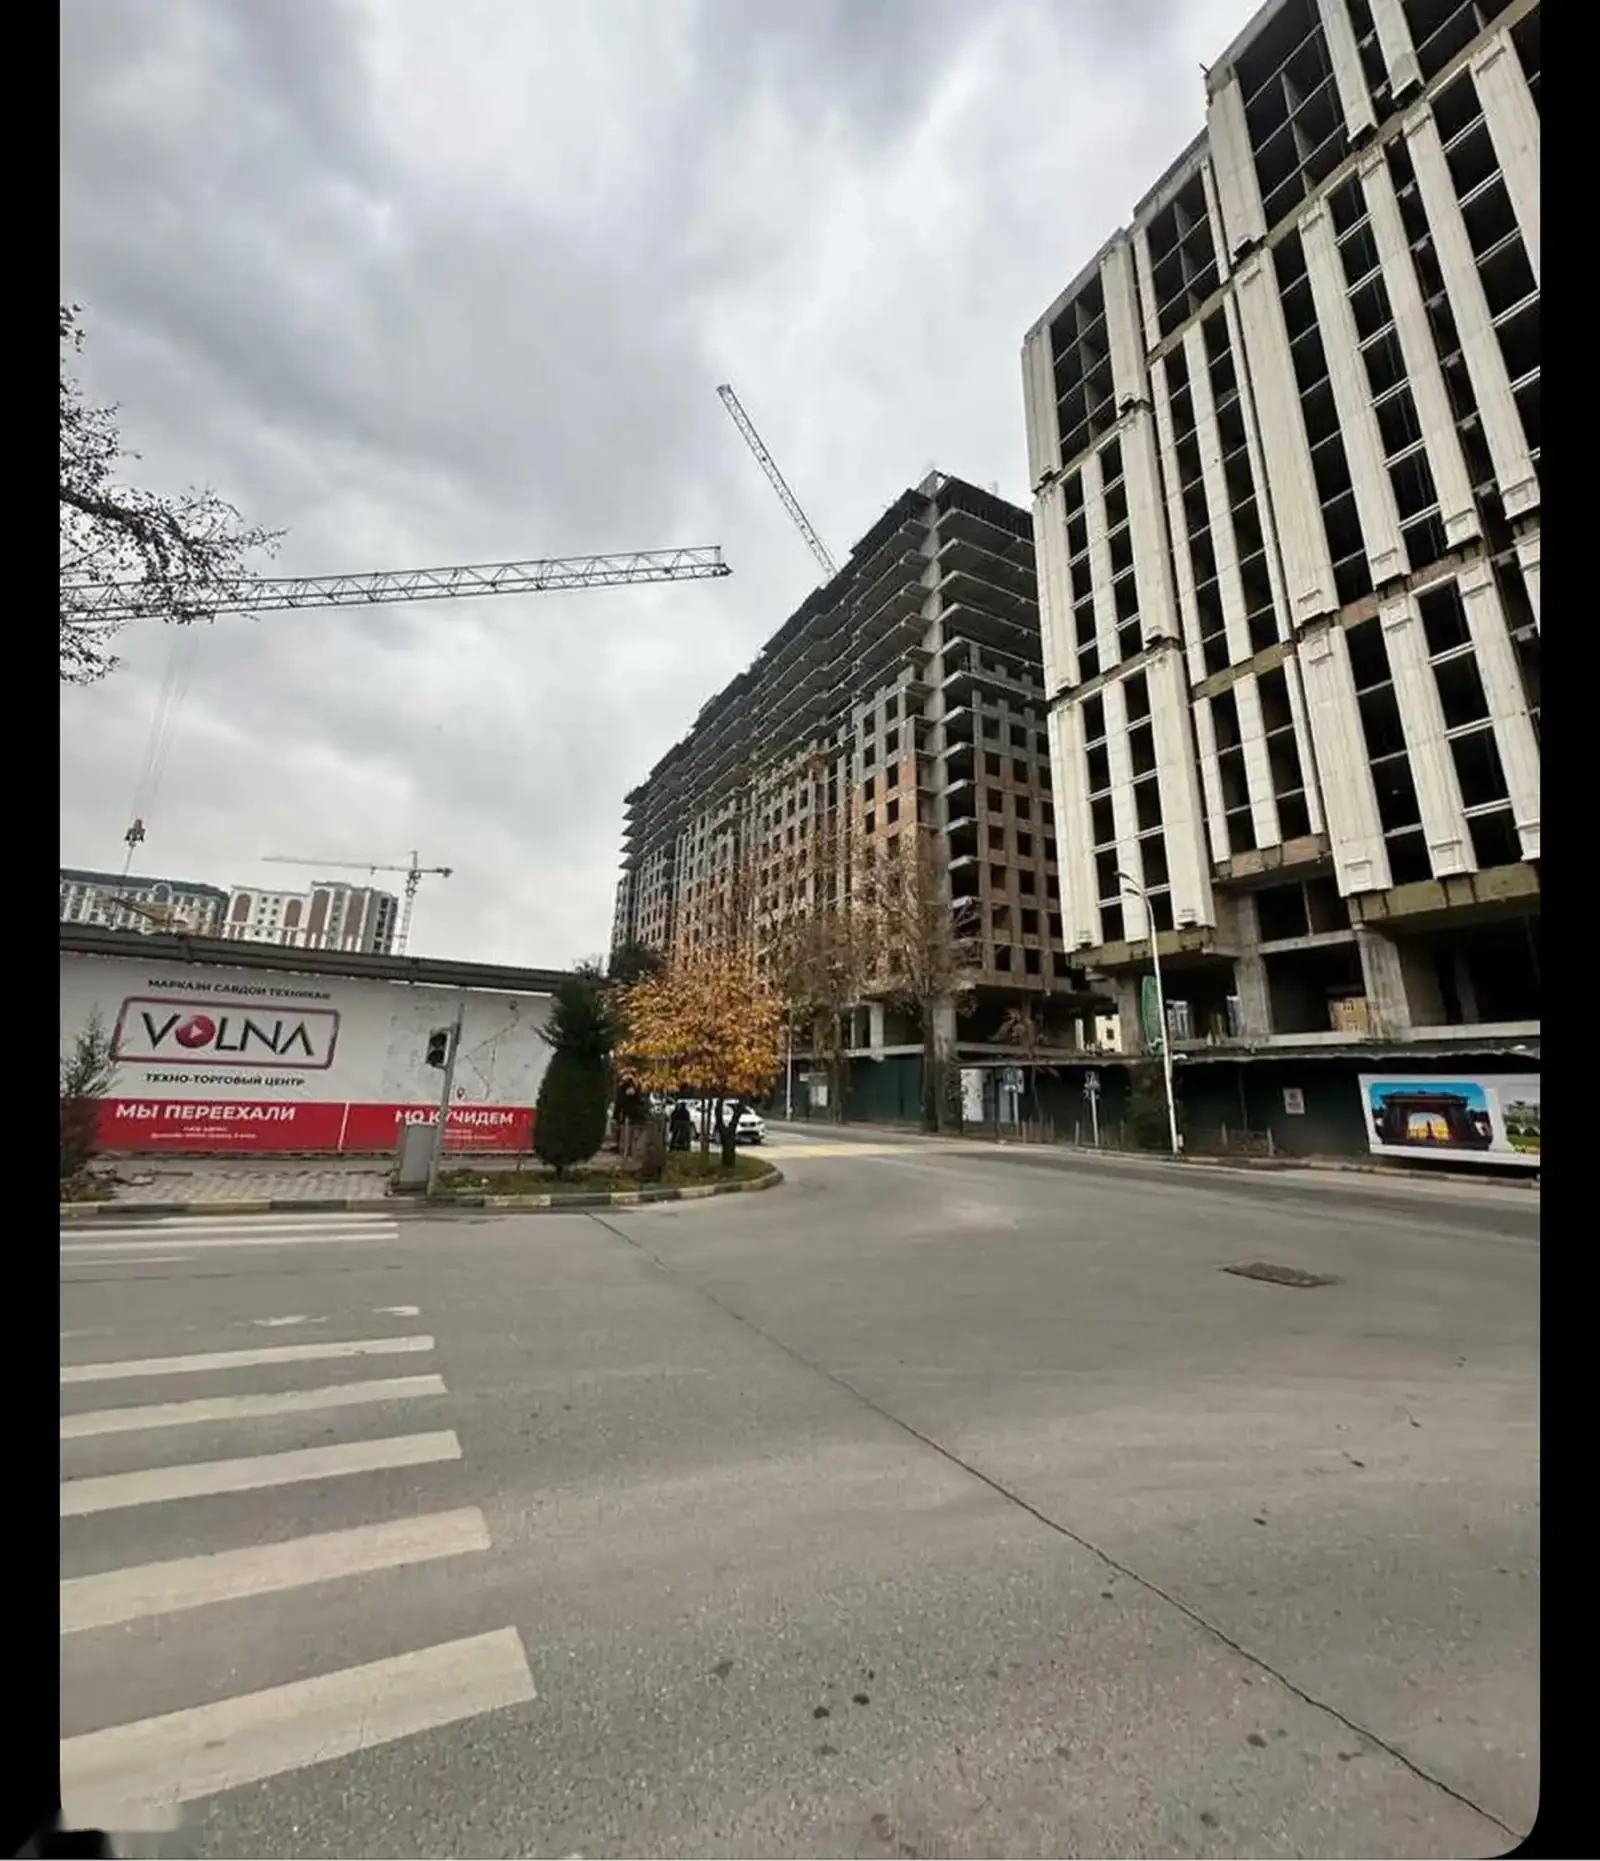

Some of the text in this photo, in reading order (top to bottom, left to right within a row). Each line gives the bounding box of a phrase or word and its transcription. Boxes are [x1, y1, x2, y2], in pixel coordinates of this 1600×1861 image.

[148, 979, 211, 993] МАРКАЗИ
[141, 1012, 315, 1056] VOLNA
[146, 1073, 304, 1087] ТЕХНО-ТОРГОВЫЙ ЦЕНТР
[116, 1104, 296, 1121] МЫ ПЕРЕЕХАЛИ
